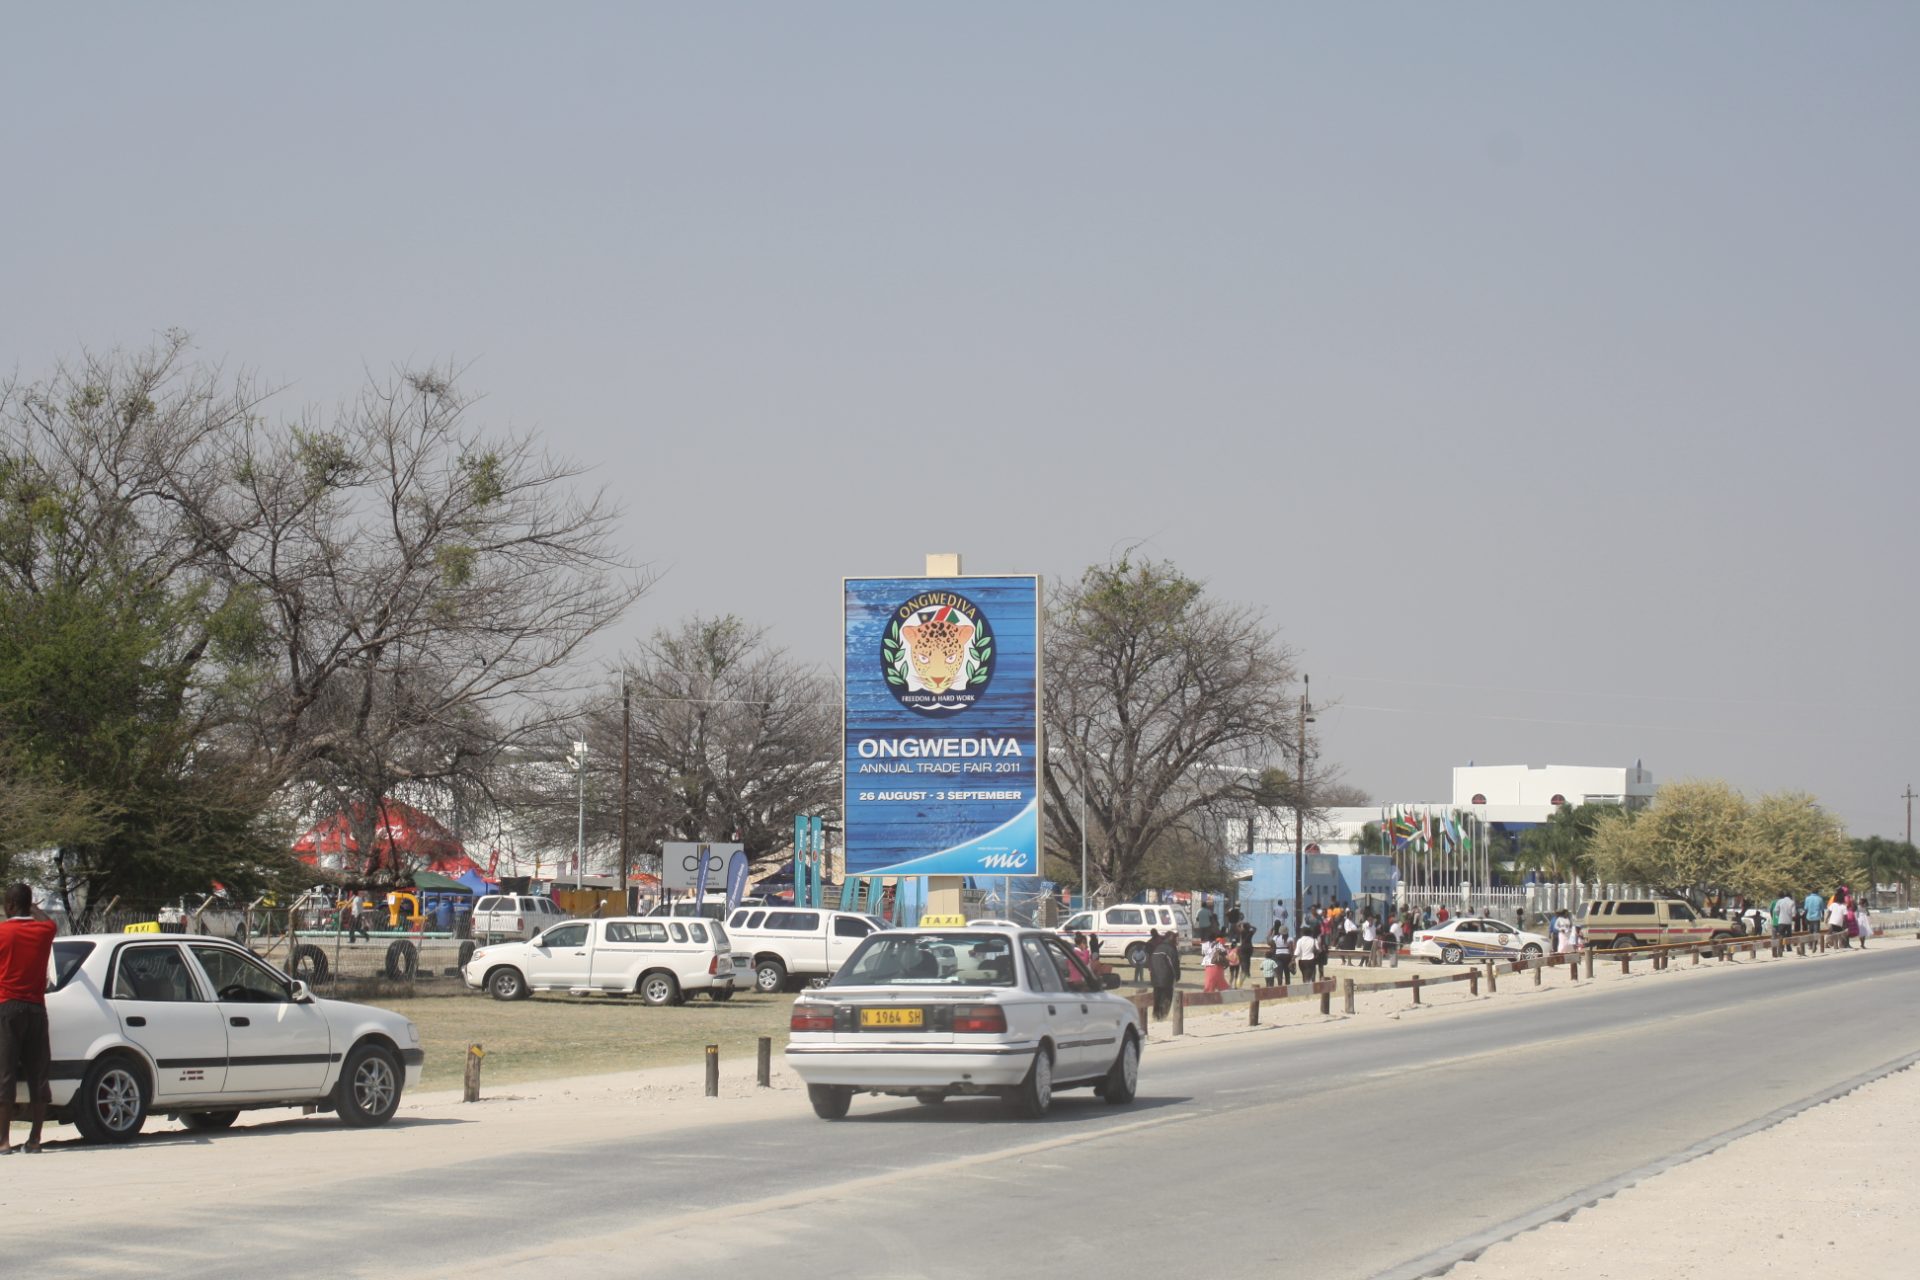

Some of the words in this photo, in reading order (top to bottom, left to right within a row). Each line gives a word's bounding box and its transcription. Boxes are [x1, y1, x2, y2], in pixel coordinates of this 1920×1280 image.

[899, 592, 977, 619] ONGWEDIVA
[858, 738, 1022, 758] ONGWEDIVA
[859, 763, 914, 773] ANNUAL
[916, 762, 961, 773] TRADE
[964, 762, 993, 773] FAIR
[995, 762, 1020, 773] 2011
[859, 792, 875, 801] 26
[878, 791, 927, 801] AUGUST
[936, 791, 945, 800] 3
[947, 791, 1022, 800] SEPTEMBER
[128, 925, 149, 933] TAXI
[862, 1011, 868, 1023] N
[876, 1011, 901, 1023] 1964
[908, 1011, 921, 1023] SH
